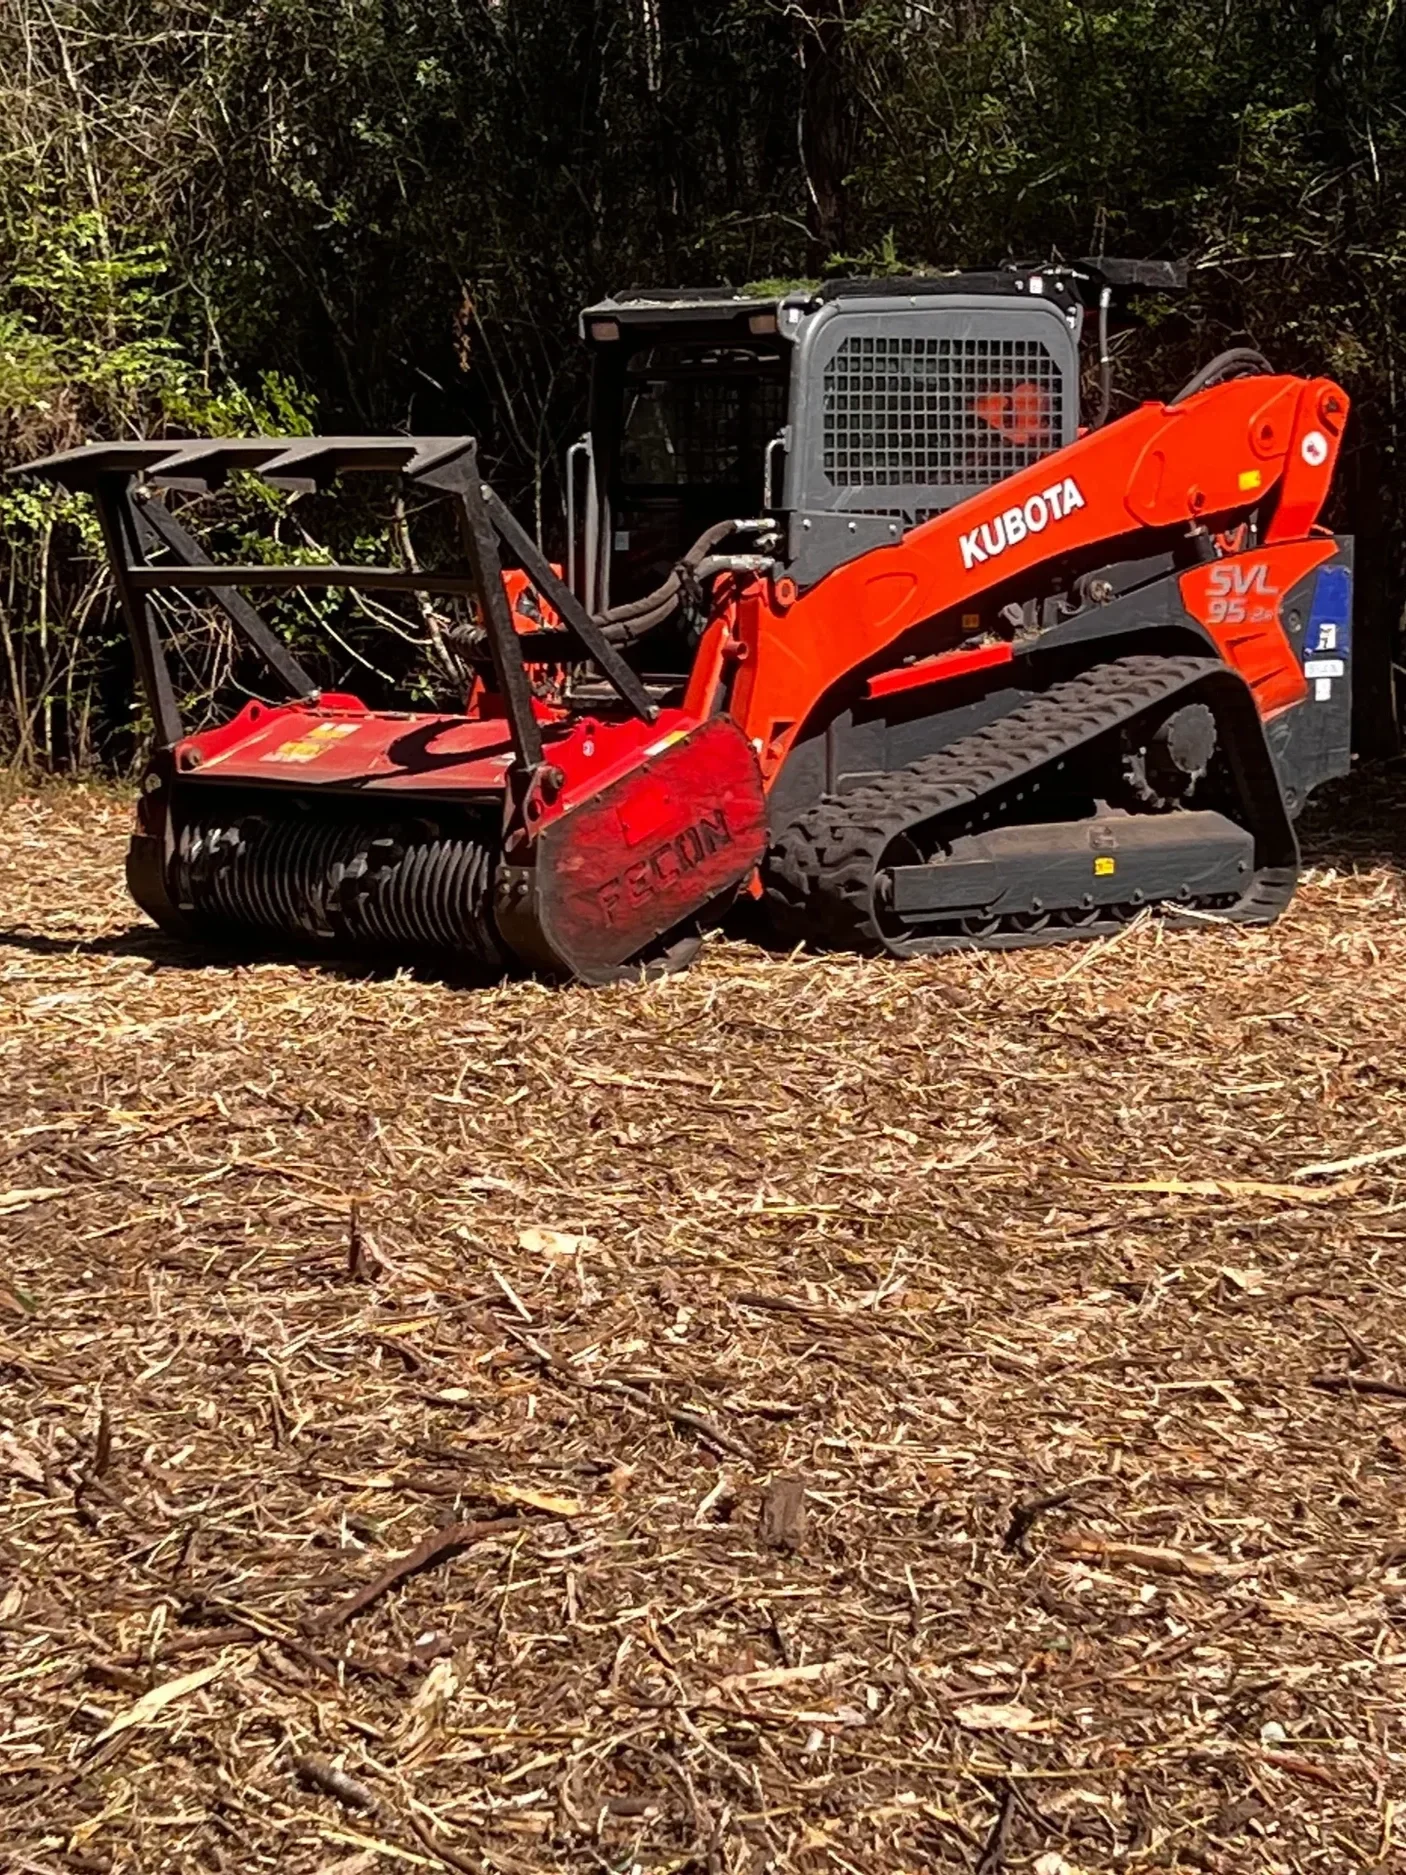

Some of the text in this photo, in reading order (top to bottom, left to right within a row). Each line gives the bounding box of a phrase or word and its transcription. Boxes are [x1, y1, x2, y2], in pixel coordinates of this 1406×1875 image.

[958, 476, 1086, 569] KUBOTA
[1205, 565, 1279, 596] SVL
[597, 808, 733, 927] FECON
